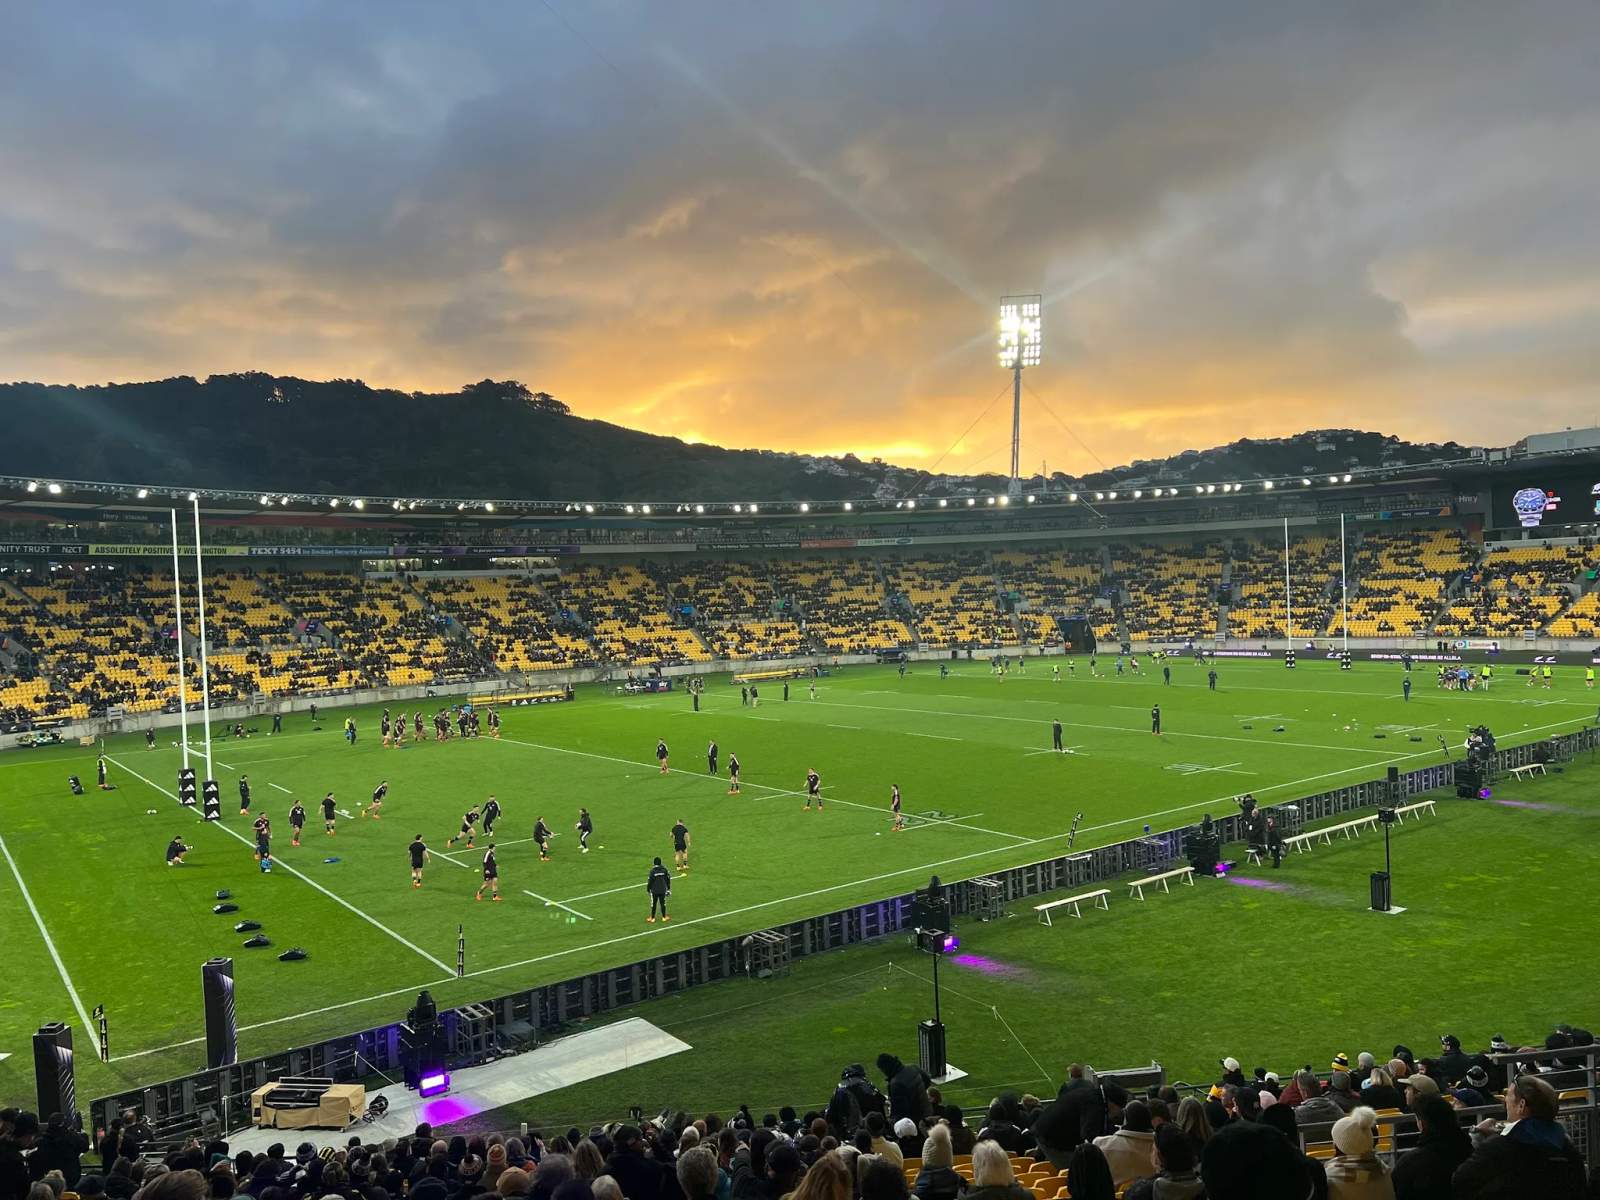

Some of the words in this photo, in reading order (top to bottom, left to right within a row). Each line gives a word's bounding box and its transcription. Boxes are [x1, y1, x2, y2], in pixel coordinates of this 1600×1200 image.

[24, 545, 50, 553] TRUST
[95, 546, 140, 554] ABSOLUTELY
[143, 546, 181, 554] POSITIVEY
